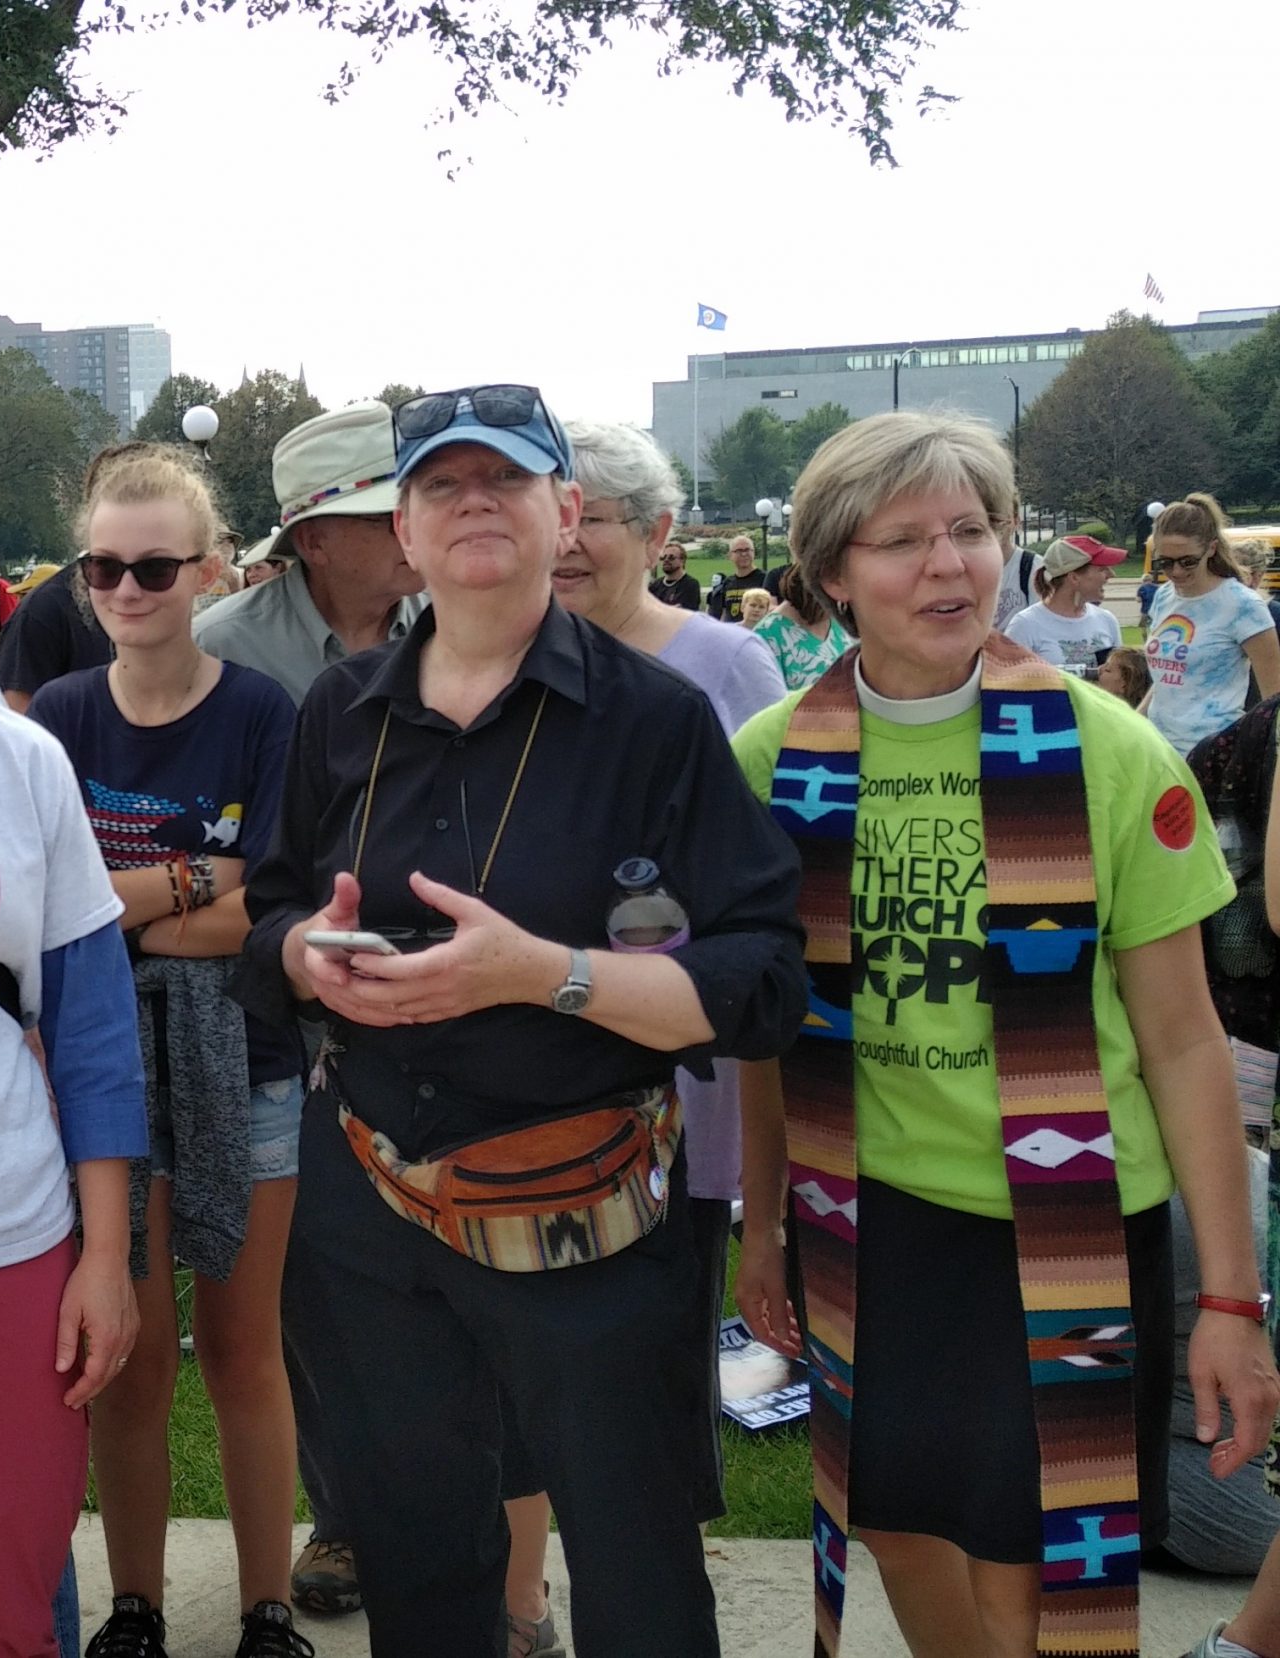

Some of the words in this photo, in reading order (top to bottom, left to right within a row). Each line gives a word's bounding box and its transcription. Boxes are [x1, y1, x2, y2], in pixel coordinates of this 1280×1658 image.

[1160, 673, 1185, 686] ALL
[857, 772, 934, 802] Complex
[925, 1044, 989, 1070] Church
[741, 1410, 781, 1423] NO
